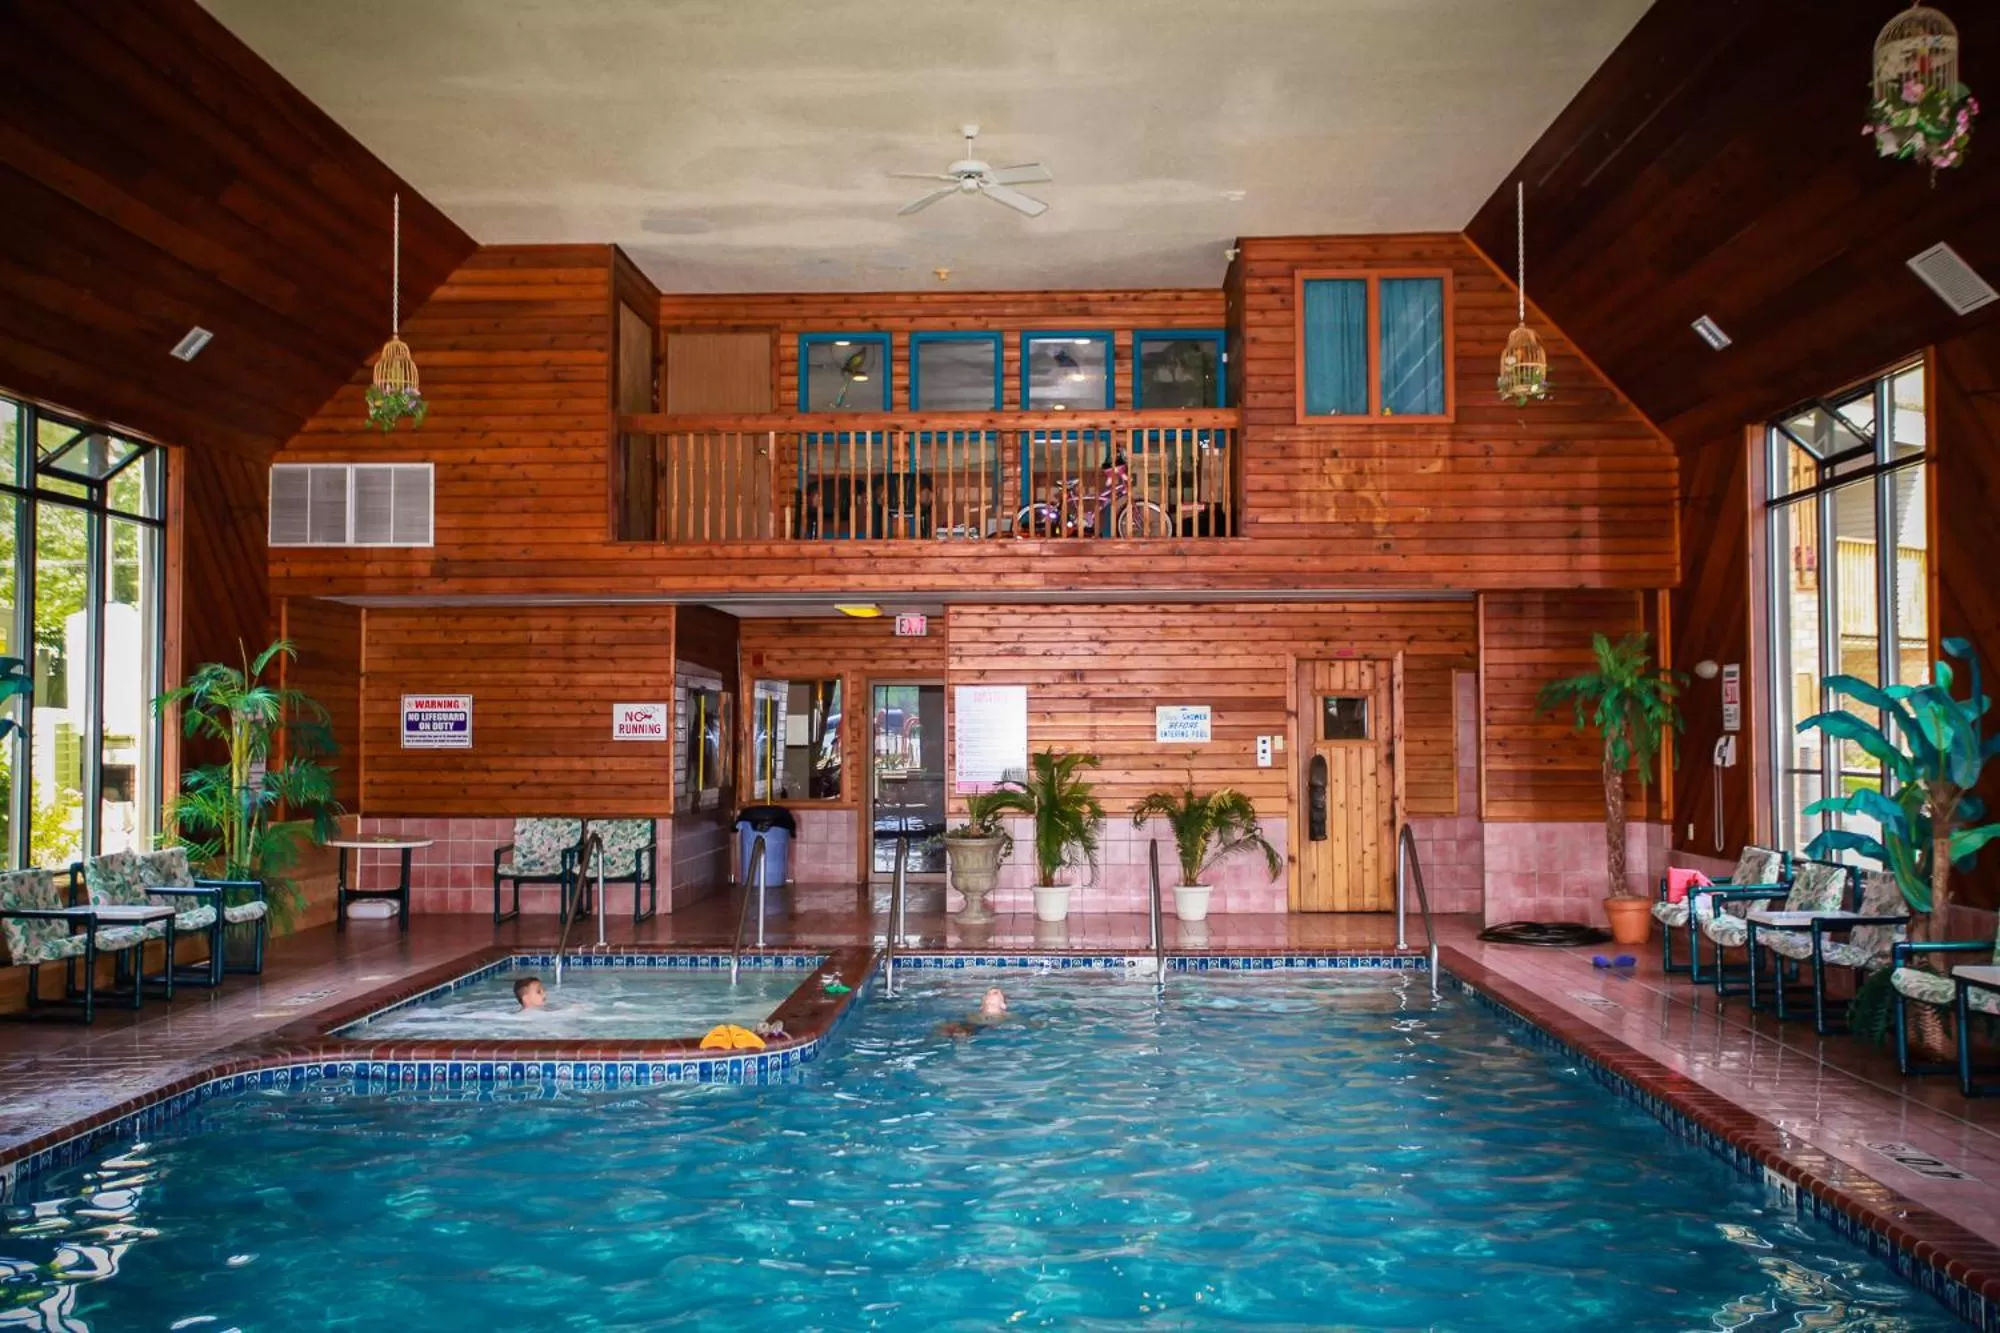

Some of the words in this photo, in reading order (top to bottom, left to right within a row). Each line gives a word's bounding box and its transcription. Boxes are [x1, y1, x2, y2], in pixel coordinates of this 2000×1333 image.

[415, 700, 460, 709] WARNING
[407, 712, 420, 722] NO
[421, 712, 465, 722] LIFEGUARD
[625, 711, 644, 722] NO
[418, 722, 431, 730] ON
[432, 722, 454, 730] DUTY
[618, 723, 661, 734] RUNNING
